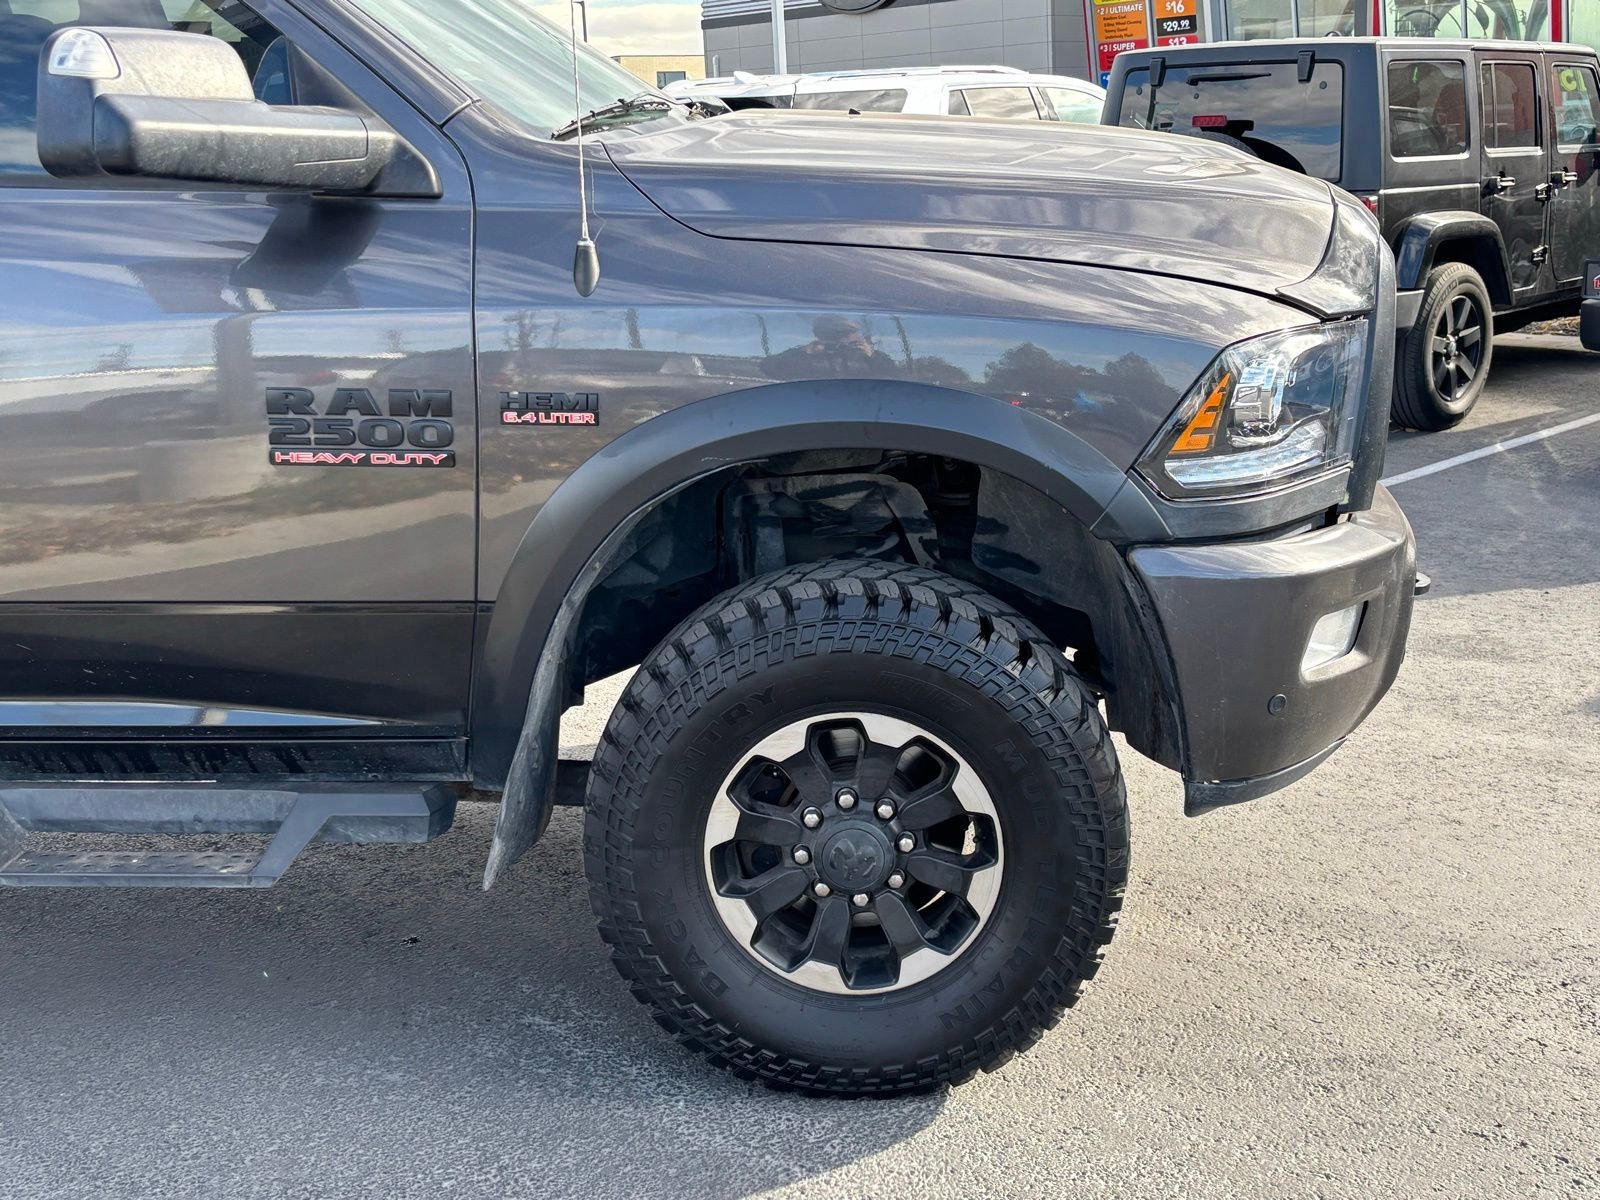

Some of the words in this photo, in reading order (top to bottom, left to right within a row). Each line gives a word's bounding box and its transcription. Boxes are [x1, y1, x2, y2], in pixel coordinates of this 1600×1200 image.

[1109, 4, 1143, 14] ULTIMATE
[1165, 1, 1185, 14] $16
[1163, 19, 1190, 31] $29.99
[1112, 42, 1135, 51] SUPER
[265, 386, 453, 418] RAM
[499, 391, 599, 411] HEMI
[503, 411, 537, 423] 6.4
[538, 412, 595, 424] LITER
[268, 417, 455, 448] 2500
[274, 451, 367, 465] HEAVY
[370, 453, 448, 466] DUTY
[651, 686, 775, 865] COUNTRY
[995, 737, 1056, 834] MUD
[655, 886, 730, 1000] BACK
[937, 856, 1057, 1030] TERRAIN
